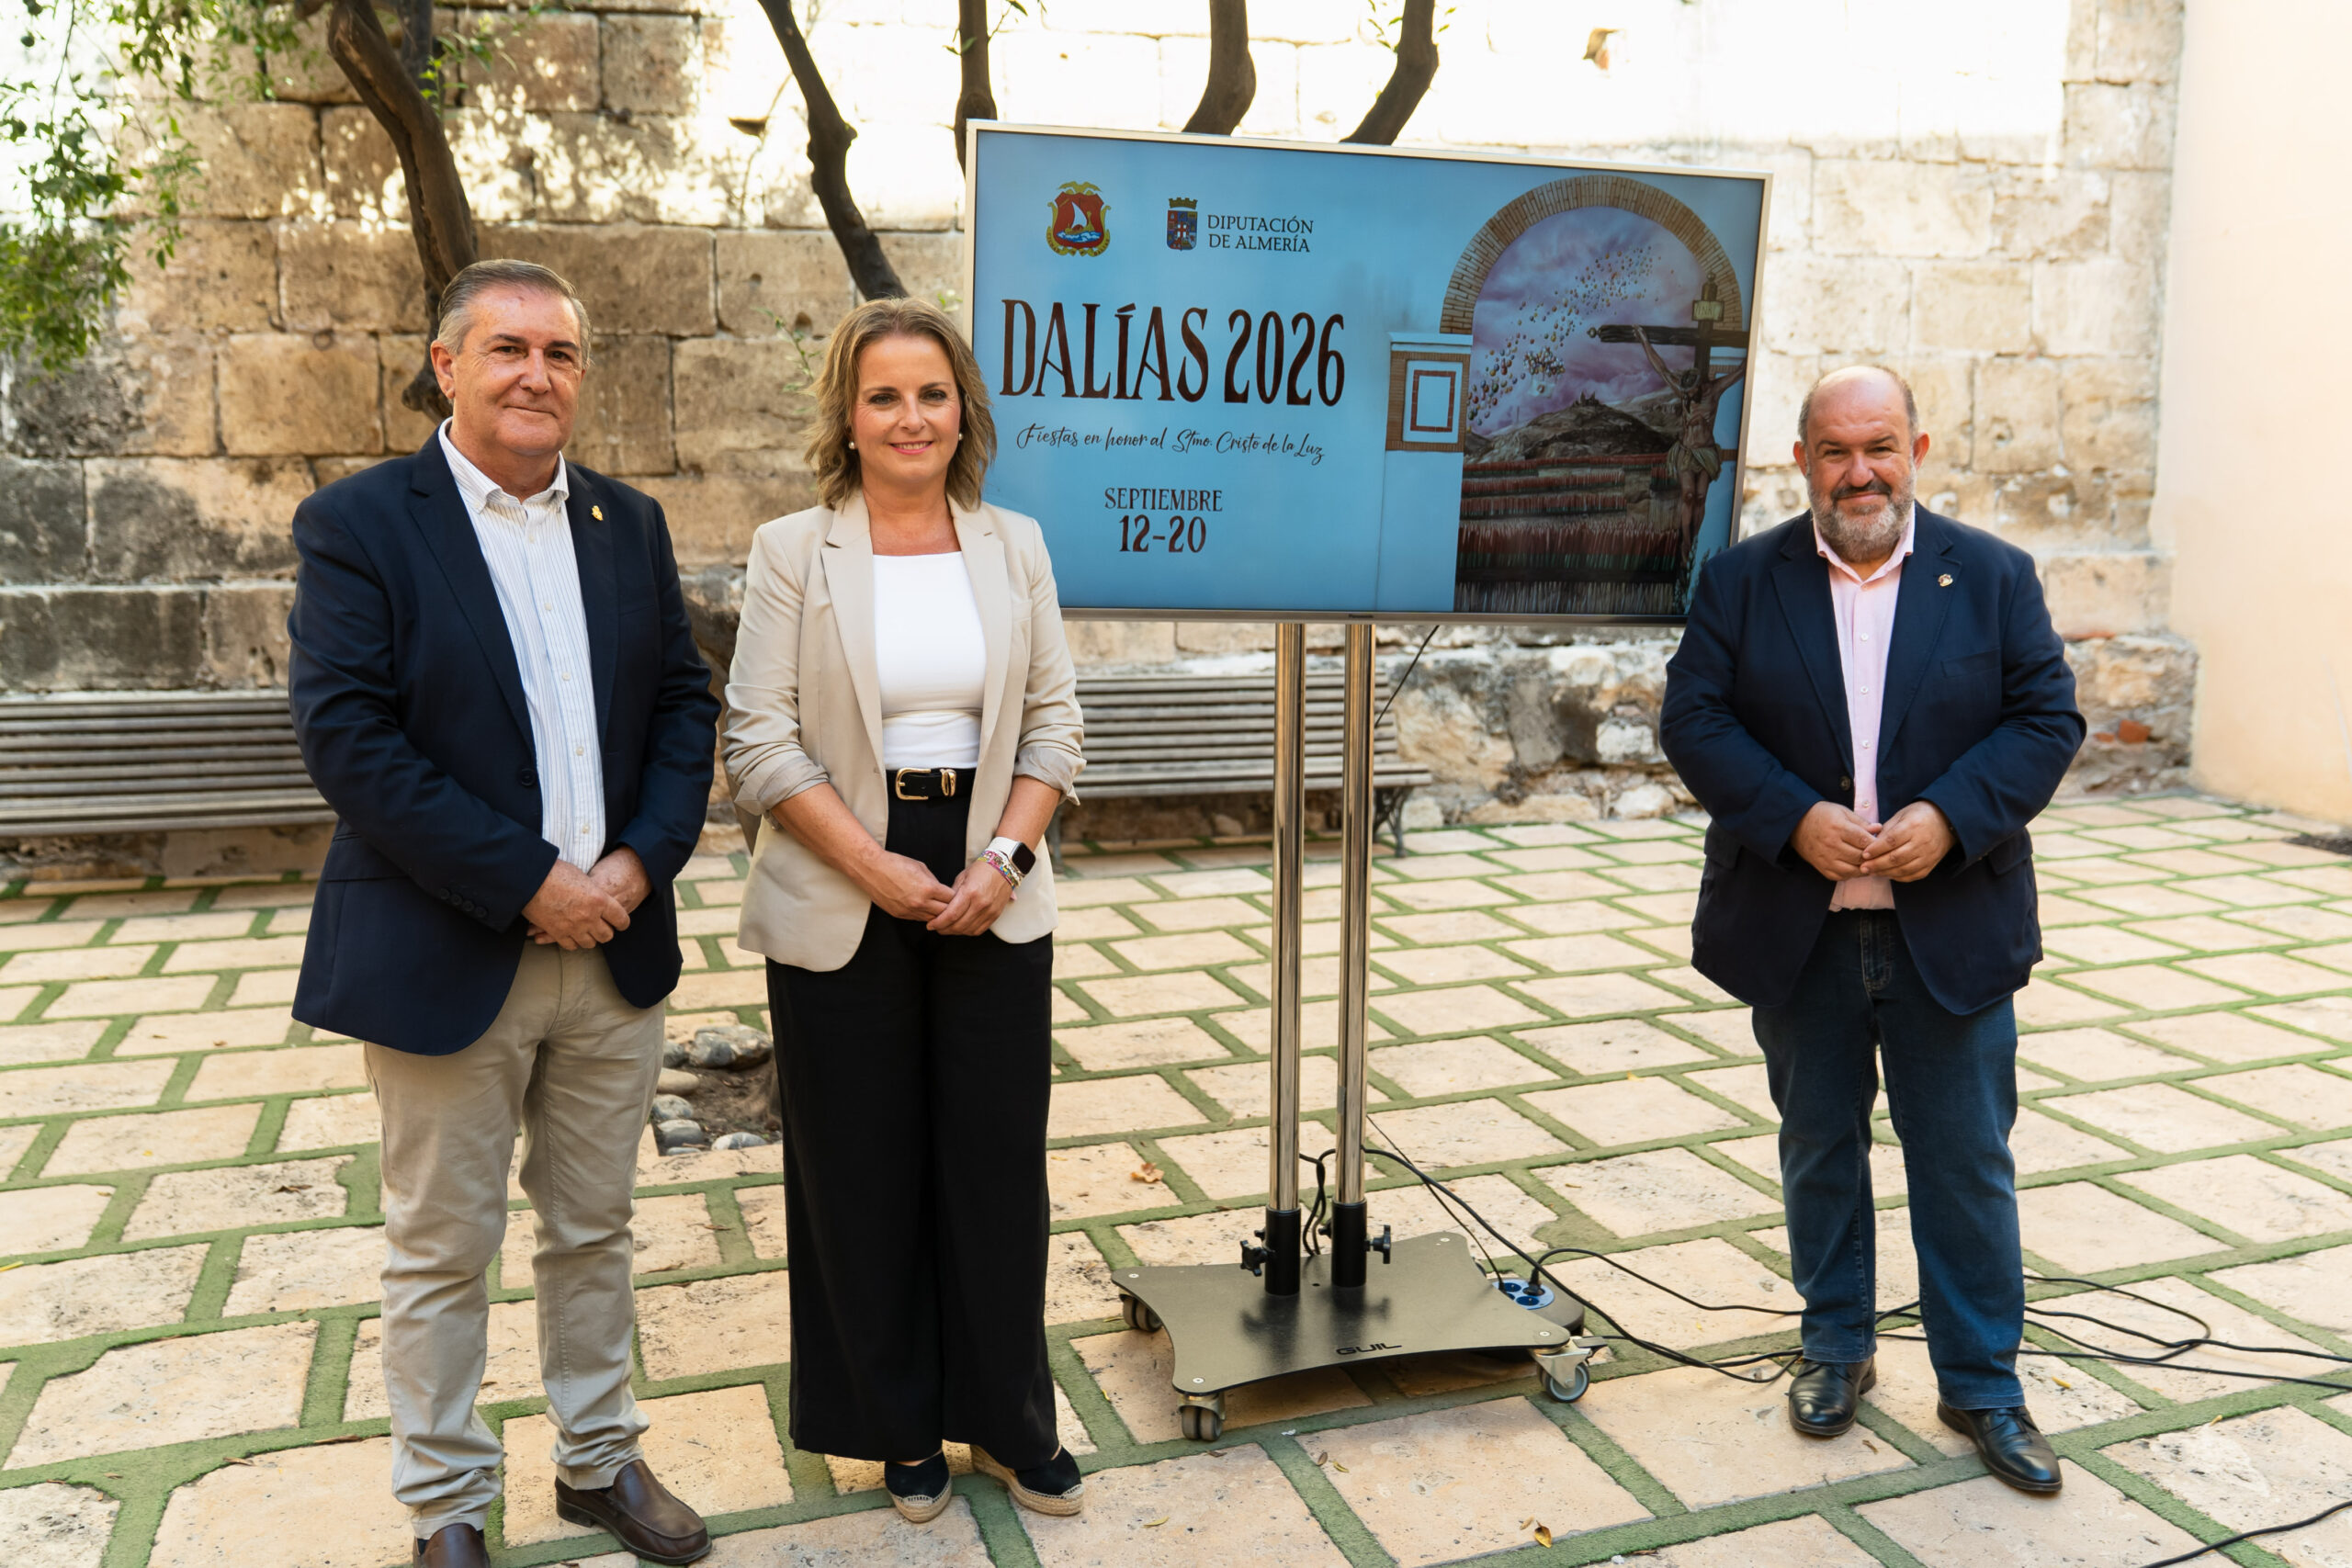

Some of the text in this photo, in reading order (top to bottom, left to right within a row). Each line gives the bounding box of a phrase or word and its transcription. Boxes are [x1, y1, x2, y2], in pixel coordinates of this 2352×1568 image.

[1207, 214, 1314, 234] DIPUTACIÓN
[1208, 233, 1311, 253] DE ALMERÍA
[999, 299, 1345, 407] DALÍAS 2026
[1016, 423, 1079, 449] Fiestas
[1083, 434, 1102, 446] en
[1104, 426, 1148, 451] honor
[1149, 426, 1168, 449] al
[1216, 431, 1261, 454] Cristo
[1261, 433, 1280, 456] de
[1282, 434, 1295, 453] la
[1293, 433, 1325, 466] Luz
[1103, 487, 1223, 513] SEPTIEMBRE
[1119, 513, 1206, 553] 12-20
[1336, 1342, 1403, 1356] GUIL
